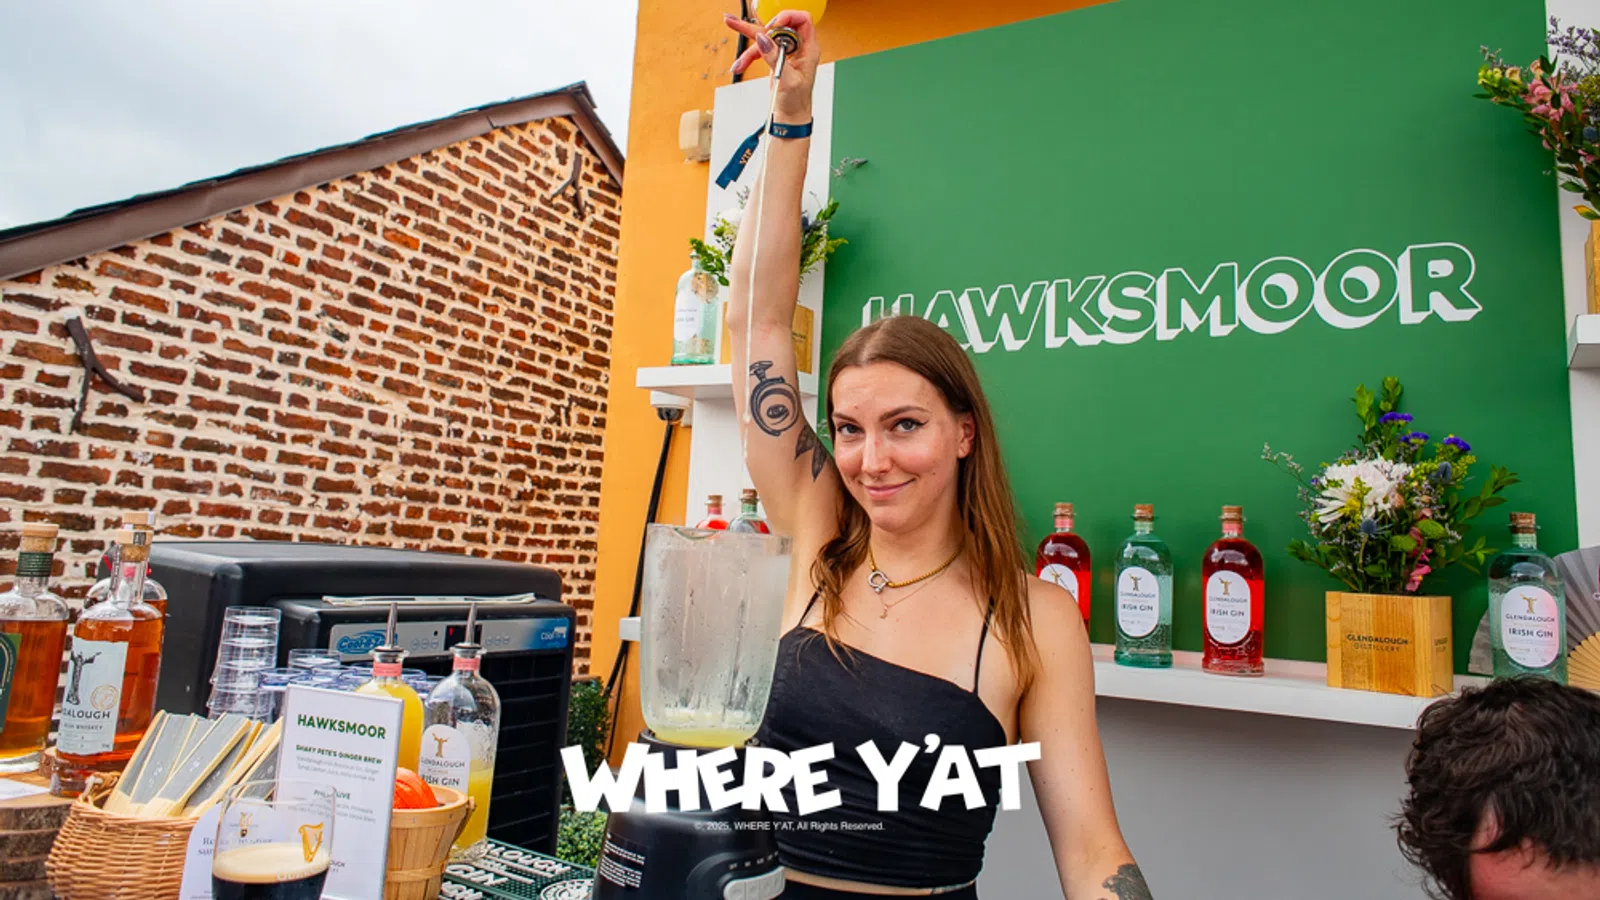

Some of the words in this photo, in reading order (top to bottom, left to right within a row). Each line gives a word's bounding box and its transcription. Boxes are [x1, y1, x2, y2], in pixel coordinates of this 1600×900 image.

[1505, 613, 1556, 623] GLENDALOUGH
[1508, 628, 1534, 637] IRISH
[1536, 629, 1554, 638] GIN
[1346, 634, 1409, 645] GLENDALOUGH
[1353, 642, 1401, 652] DISTILLERY
[297, 714, 387, 739] HAWKSMOOR
[441, 777, 460, 786] GIN
